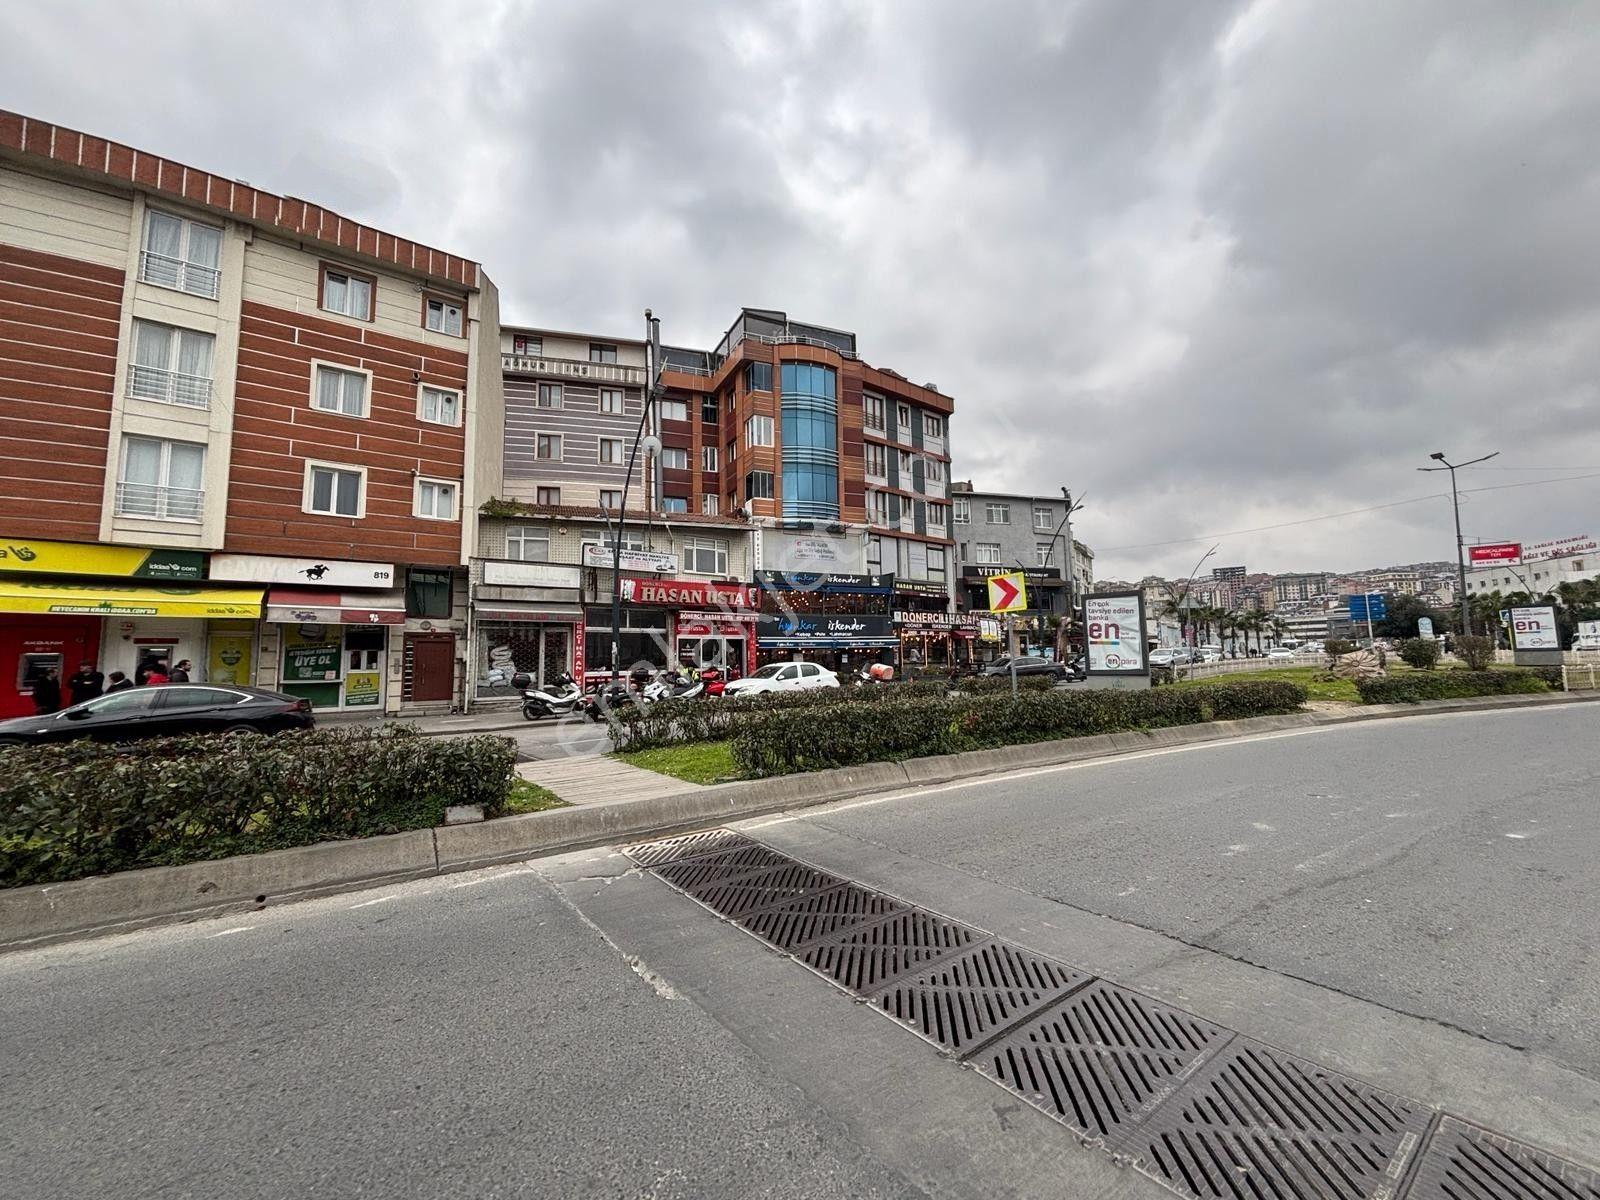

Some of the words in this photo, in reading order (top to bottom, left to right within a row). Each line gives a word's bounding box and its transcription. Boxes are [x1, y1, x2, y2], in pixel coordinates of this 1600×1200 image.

[1540, 550, 1549, 558] VE
[1566, 542, 1597, 553] SAĞLIĞI
[373, 571, 390, 580] 819
[977, 566, 1011, 577] VİTRİN
[827, 573, 861, 584] iskender
[641, 587, 702, 603] HASAN
[706, 589, 746, 606] USTA
[828, 618, 867, 632] iskender
[1515, 620, 1541, 631] en
[1088, 623, 1120, 640] en
[318, 655, 331, 665] OL
